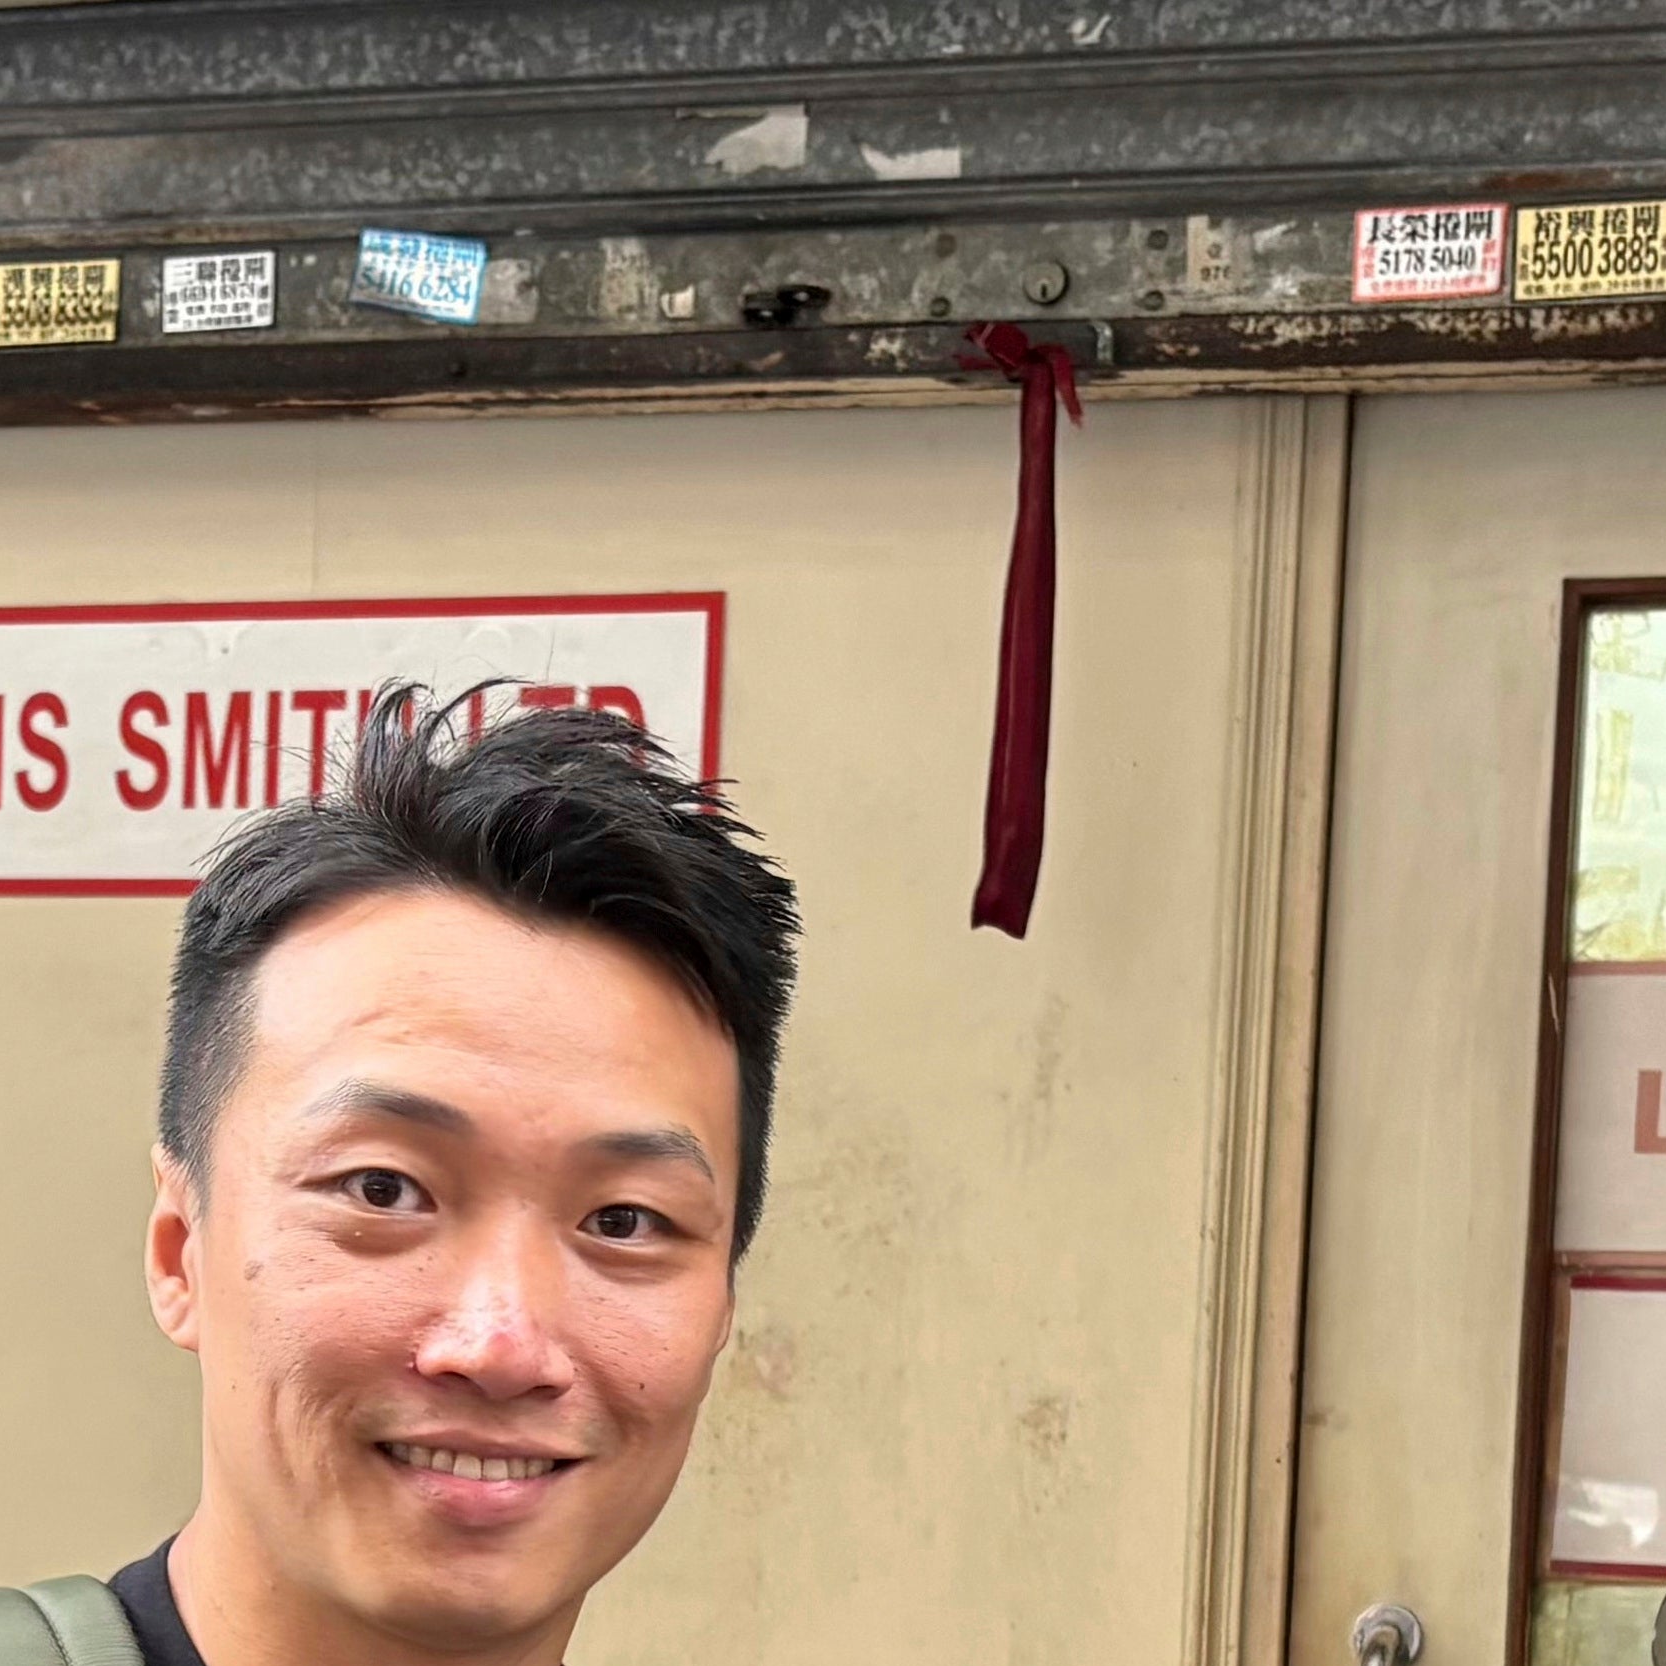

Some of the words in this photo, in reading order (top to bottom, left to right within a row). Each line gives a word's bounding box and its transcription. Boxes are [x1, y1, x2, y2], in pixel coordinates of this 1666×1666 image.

[1368, 210, 1493, 243] 長榮捲閘
[1378, 249, 1425, 275] 5178
[1429, 245, 1477, 273] 5040
[1532, 240, 1594, 280] 5500
[1597, 236, 1659, 277] 3885
